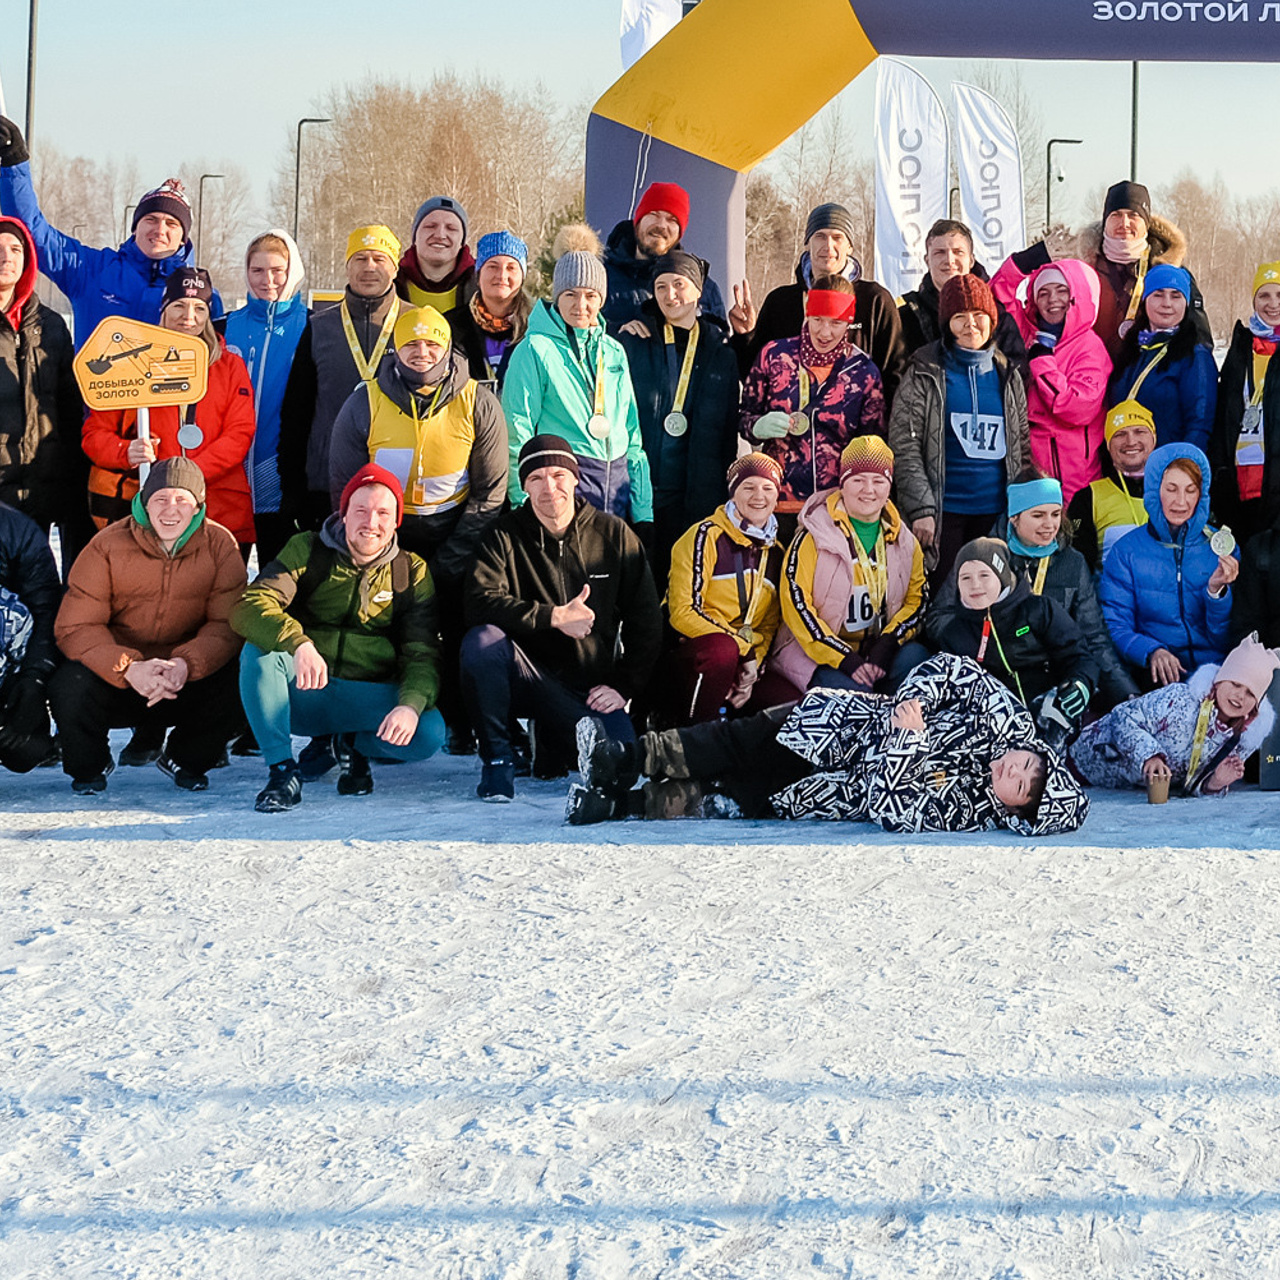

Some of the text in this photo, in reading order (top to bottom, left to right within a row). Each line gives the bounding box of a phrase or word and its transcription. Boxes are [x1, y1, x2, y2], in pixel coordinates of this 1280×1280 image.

[88, 378, 146, 391] ДОБЫВАЮ
[95, 388, 140, 400] ЗОЛОТО
[959, 420, 999, 451] 147
